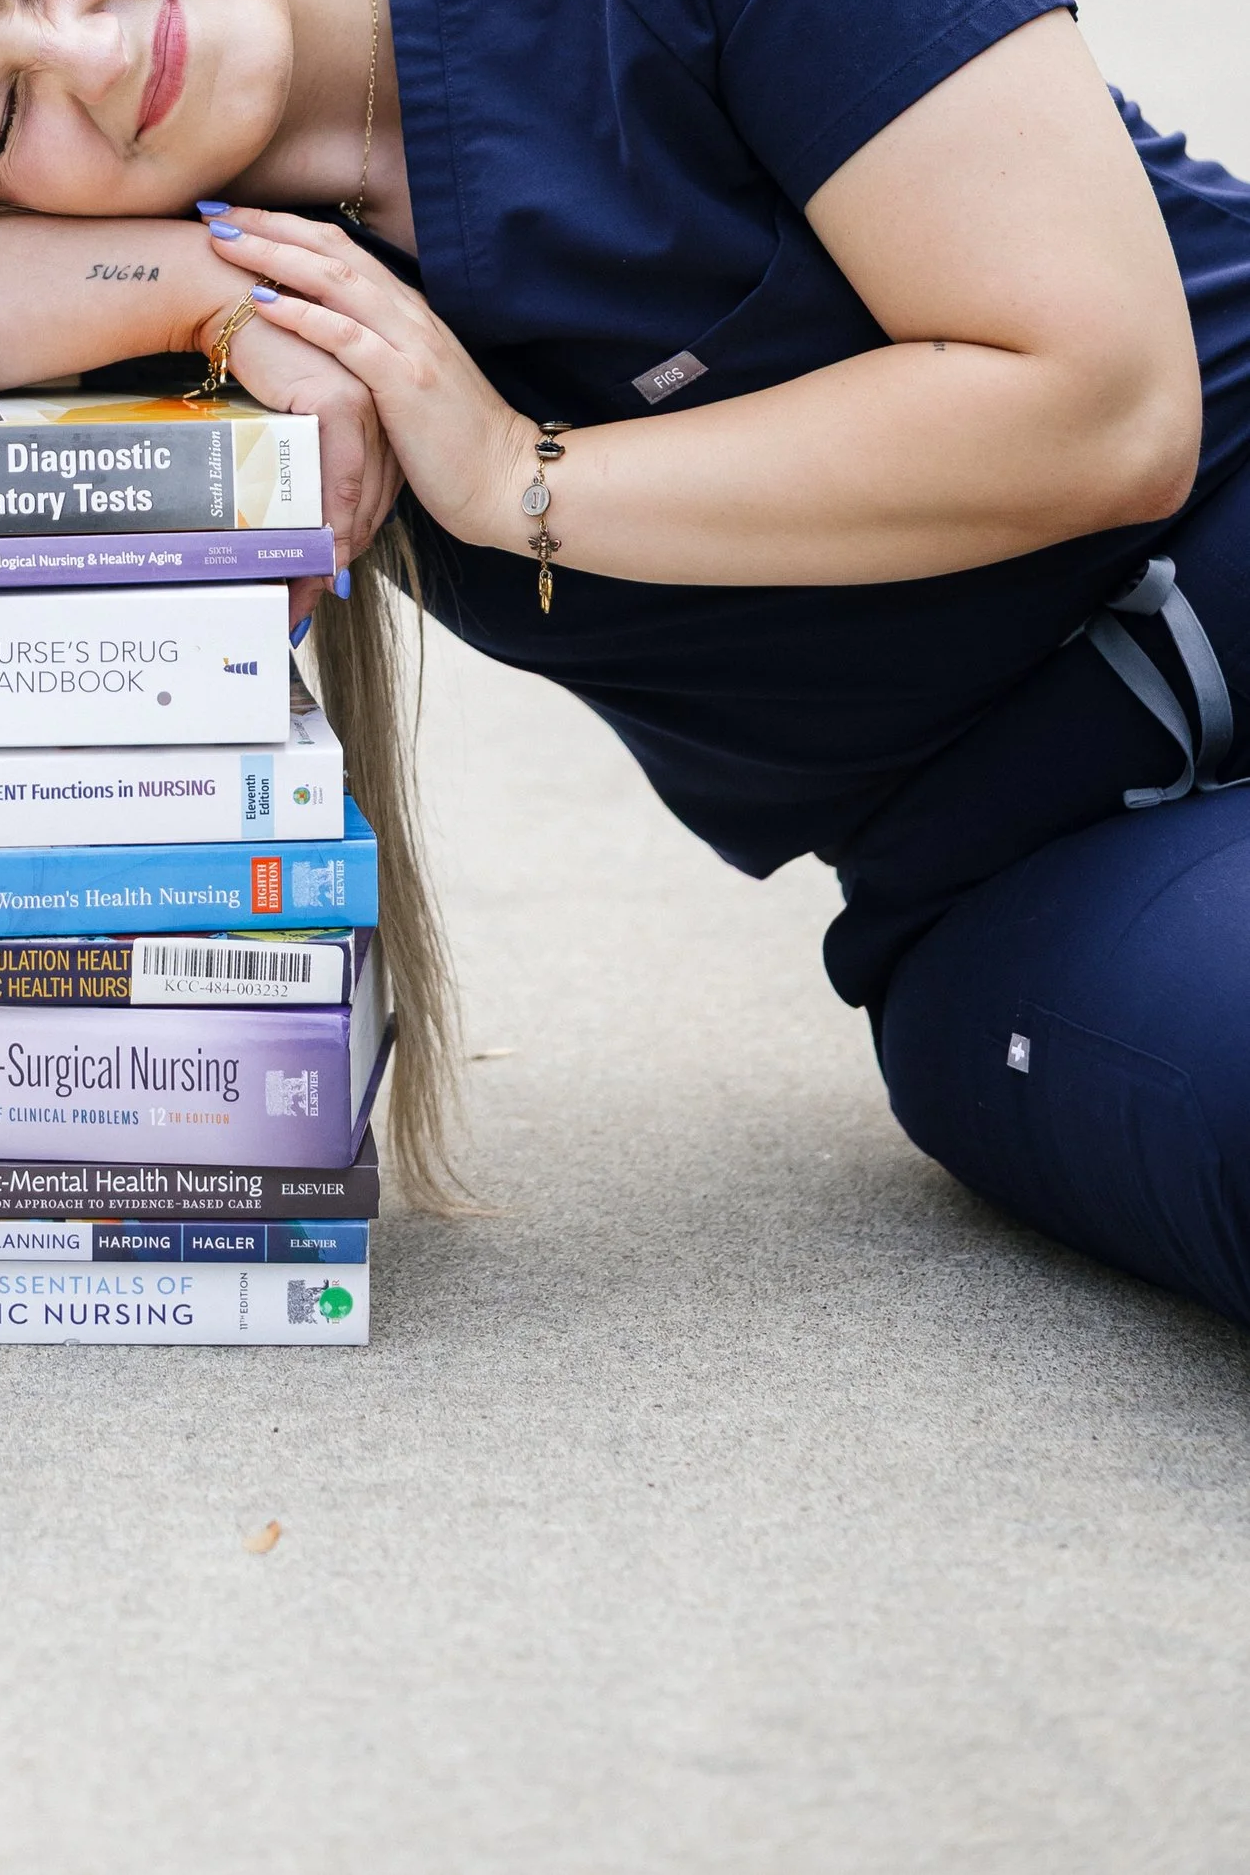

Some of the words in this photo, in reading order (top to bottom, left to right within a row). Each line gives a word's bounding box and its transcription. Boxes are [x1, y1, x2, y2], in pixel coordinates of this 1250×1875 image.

[86, 264, 160, 282] SUGAR
[653, 367, 685, 390] FIGS
[7, 440, 172, 478] Diagnostic
[209, 430, 223, 479] Edition
[280, 438, 290, 503] ELSEVIER
[73, 483, 153, 513] Tests
[209, 480, 223, 518] Sixth
[39, 553, 85, 572] Nursing
[87, 554, 97, 566] &
[99, 550, 145, 569] Healthy
[148, 551, 182, 567] Aging
[204, 556, 238, 565] EDITION
[208, 546, 233, 555] SIXTH
[257, 548, 304, 559] ELSEVIER
[100, 640, 178, 663] DRUG
[31, 781, 114, 800] Functions
[118, 780, 133, 798] in
[138, 779, 216, 798] NURSING
[245, 774, 256, 820] Eleventh
[258, 778, 270, 815] Edition
[257, 863, 267, 908] EIGHTH
[269, 861, 279, 909] EDITION
[336, 859, 345, 906] ELSEVIER
[85, 886, 152, 908] Health
[158, 884, 241, 909] Nursing
[77, 949, 133, 971] HEALT
[8, 976, 73, 998] HEALTH
[79, 976, 132, 998] NURSI
[164, 979, 289, 998] KCC-484-003232
[130, 1045, 239, 1102] Nursing
[310, 1070, 319, 1117] ELSEVIER
[9, 1107, 66, 1123] CLINICAL
[72, 1109, 139, 1125] PROBLEMS
[186, 1112, 230, 1124] EDITION
[96, 1168, 168, 1193] Health
[177, 1170, 263, 1197] Nursing
[281, 1183, 346, 1196] ELSEVIER
[15, 1199, 84, 1209] APPROACH
[88, 1199, 104, 1209] TO
[110, 1199, 224, 1209] EVIDENCE-BASED
[228, 1199, 262, 1209] CARE
[99, 1236, 170, 1250] HARDING
[192, 1237, 255, 1250] HAGLER
[290, 1239, 337, 1248] ELSEVIER
[157, 1276, 193, 1295] OF
[239, 1272, 249, 1314] EDITION
[44, 1303, 193, 1326] NURSING
